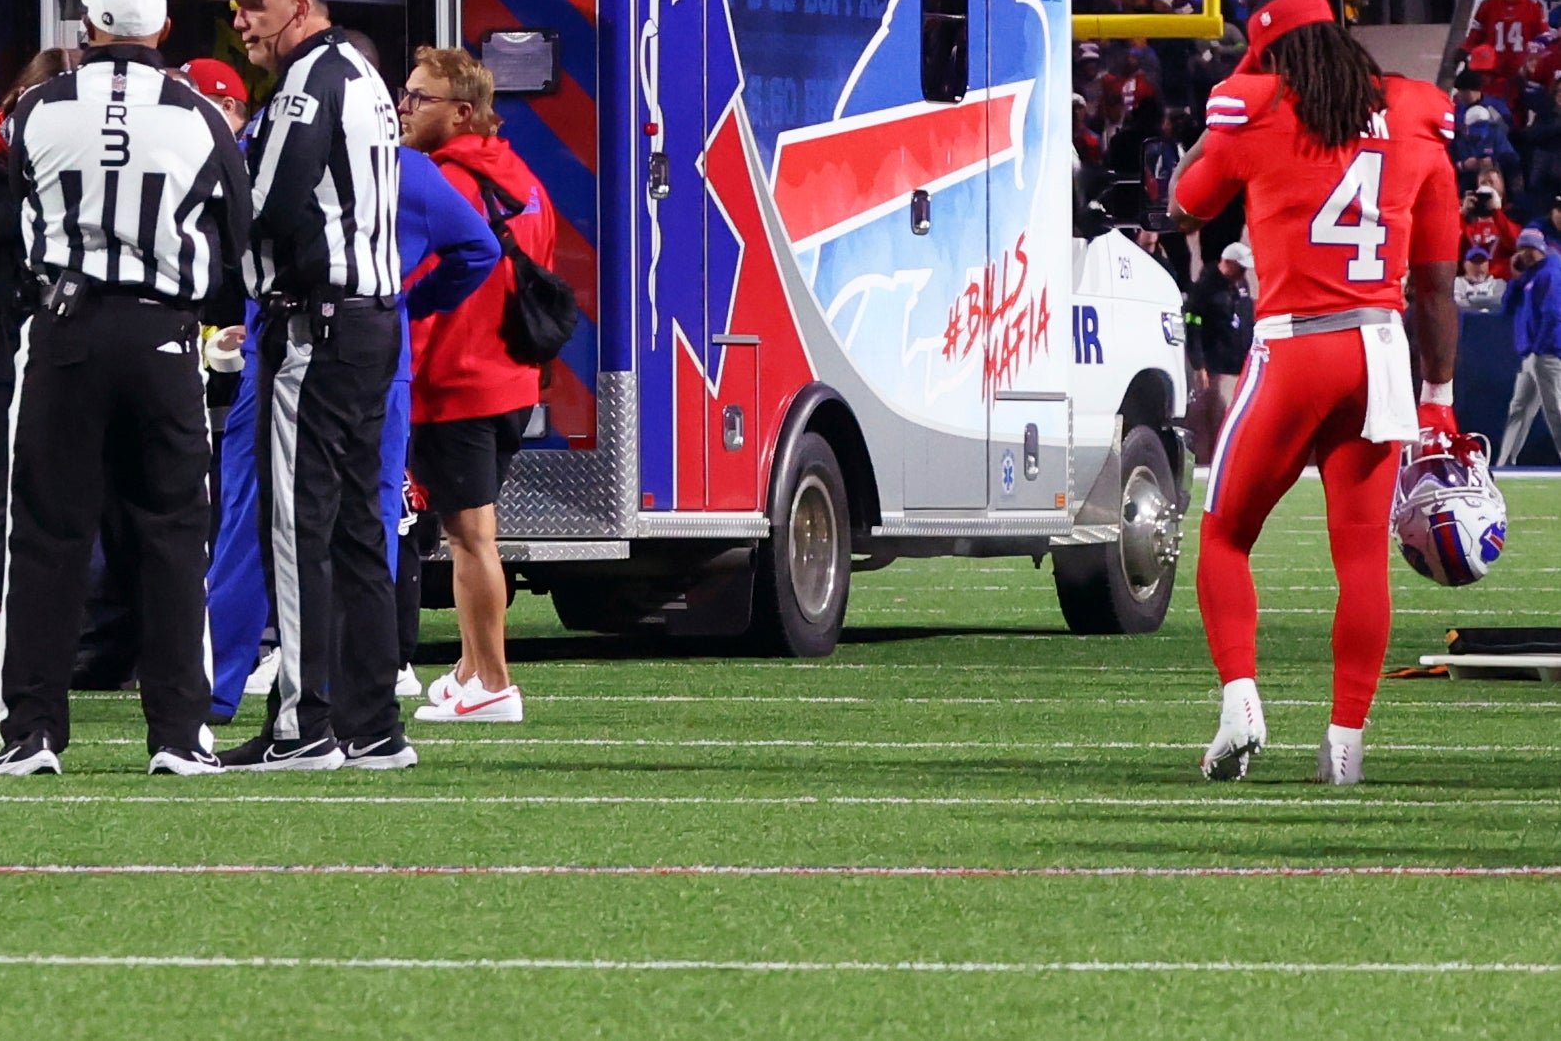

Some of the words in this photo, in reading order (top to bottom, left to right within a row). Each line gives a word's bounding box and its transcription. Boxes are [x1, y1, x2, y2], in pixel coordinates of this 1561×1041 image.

[1494, 21, 1523, 52] 14
[105, 104, 128, 125] R
[269, 94, 307, 119] 115
[100, 128, 130, 167] 3
[1309, 150, 1387, 282] 4
[1118, 256, 1134, 280] 261
[981, 278, 1051, 411] MAFIA
